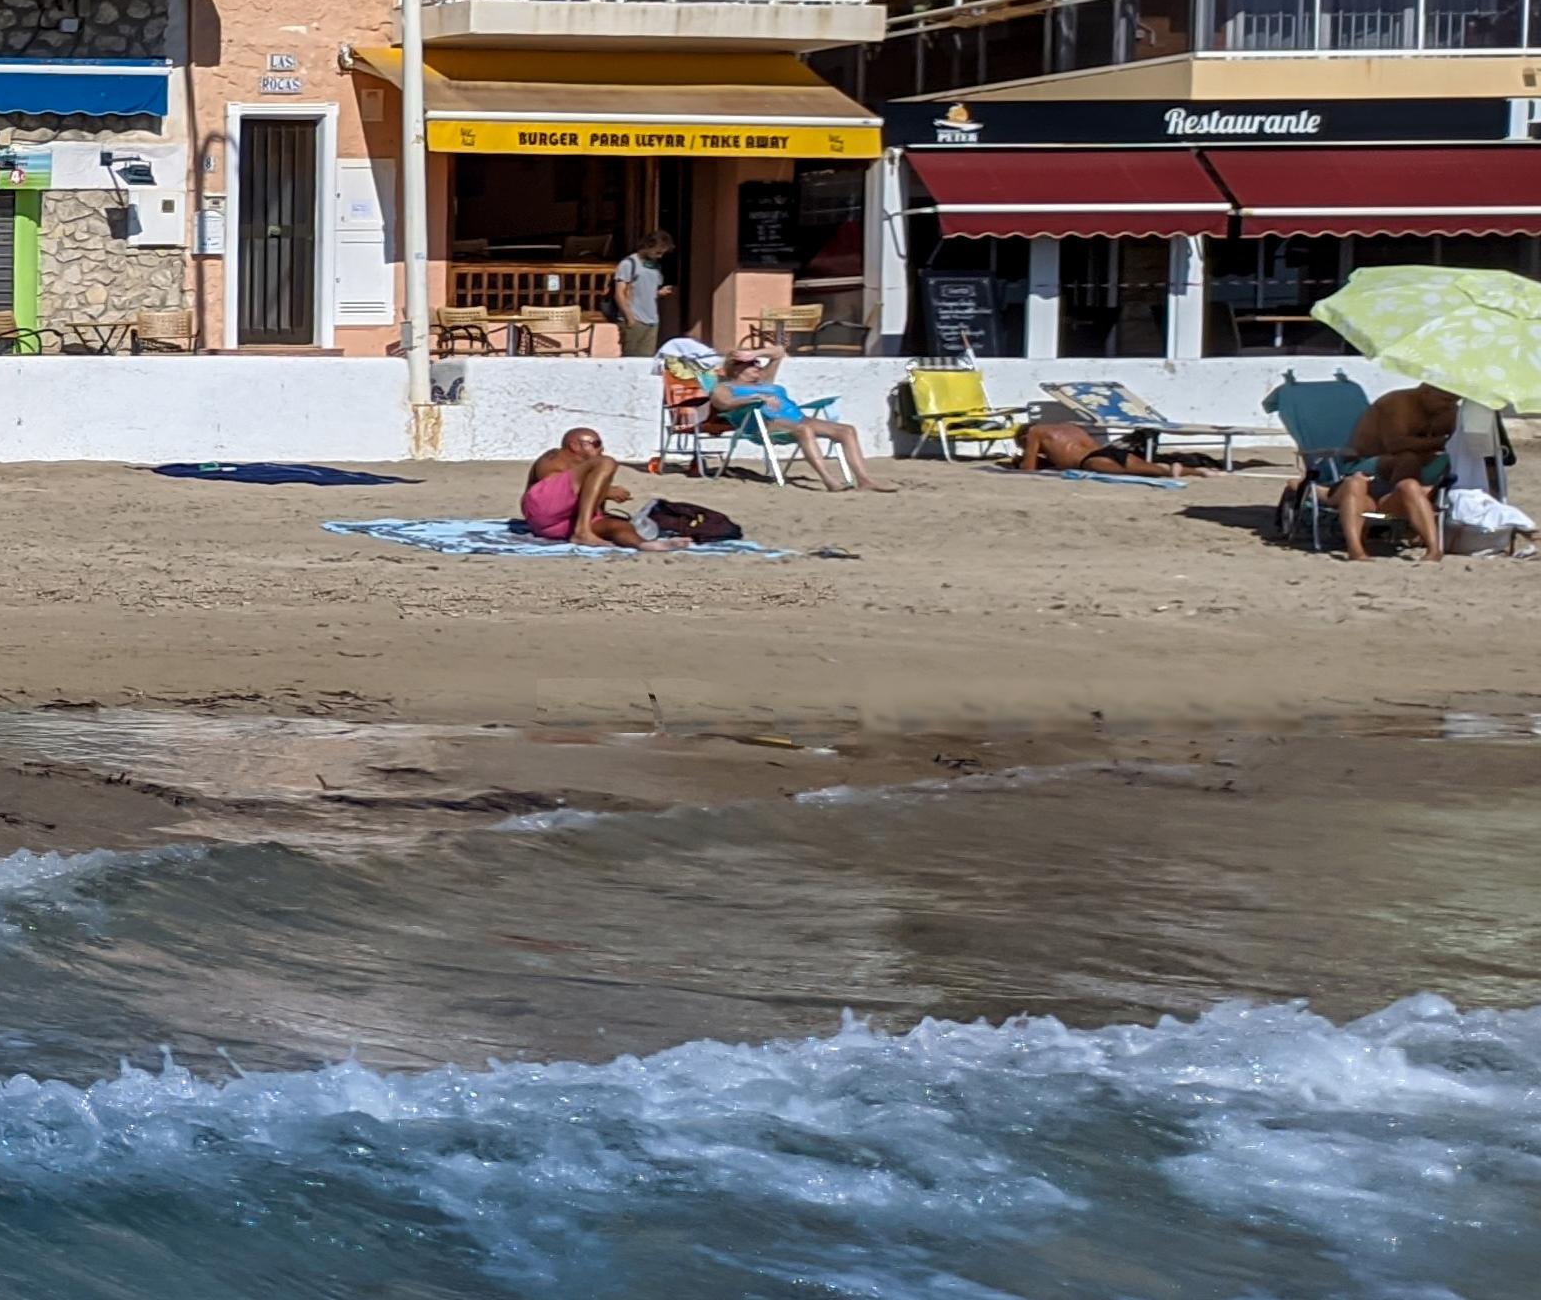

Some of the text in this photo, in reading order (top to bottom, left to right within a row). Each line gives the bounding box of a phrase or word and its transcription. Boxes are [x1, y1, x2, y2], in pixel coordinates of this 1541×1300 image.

[270, 54, 294, 68] LAS
[261, 76, 301, 91] ROCAS
[1164, 107, 1322, 135] Restaurante
[518, 131, 579, 147] BURGER
[589, 133, 630, 148] PARA
[635, 133, 685, 148] LLEVAR
[699, 134, 741, 149] TAKE
[745, 135, 790, 149] AWAY
